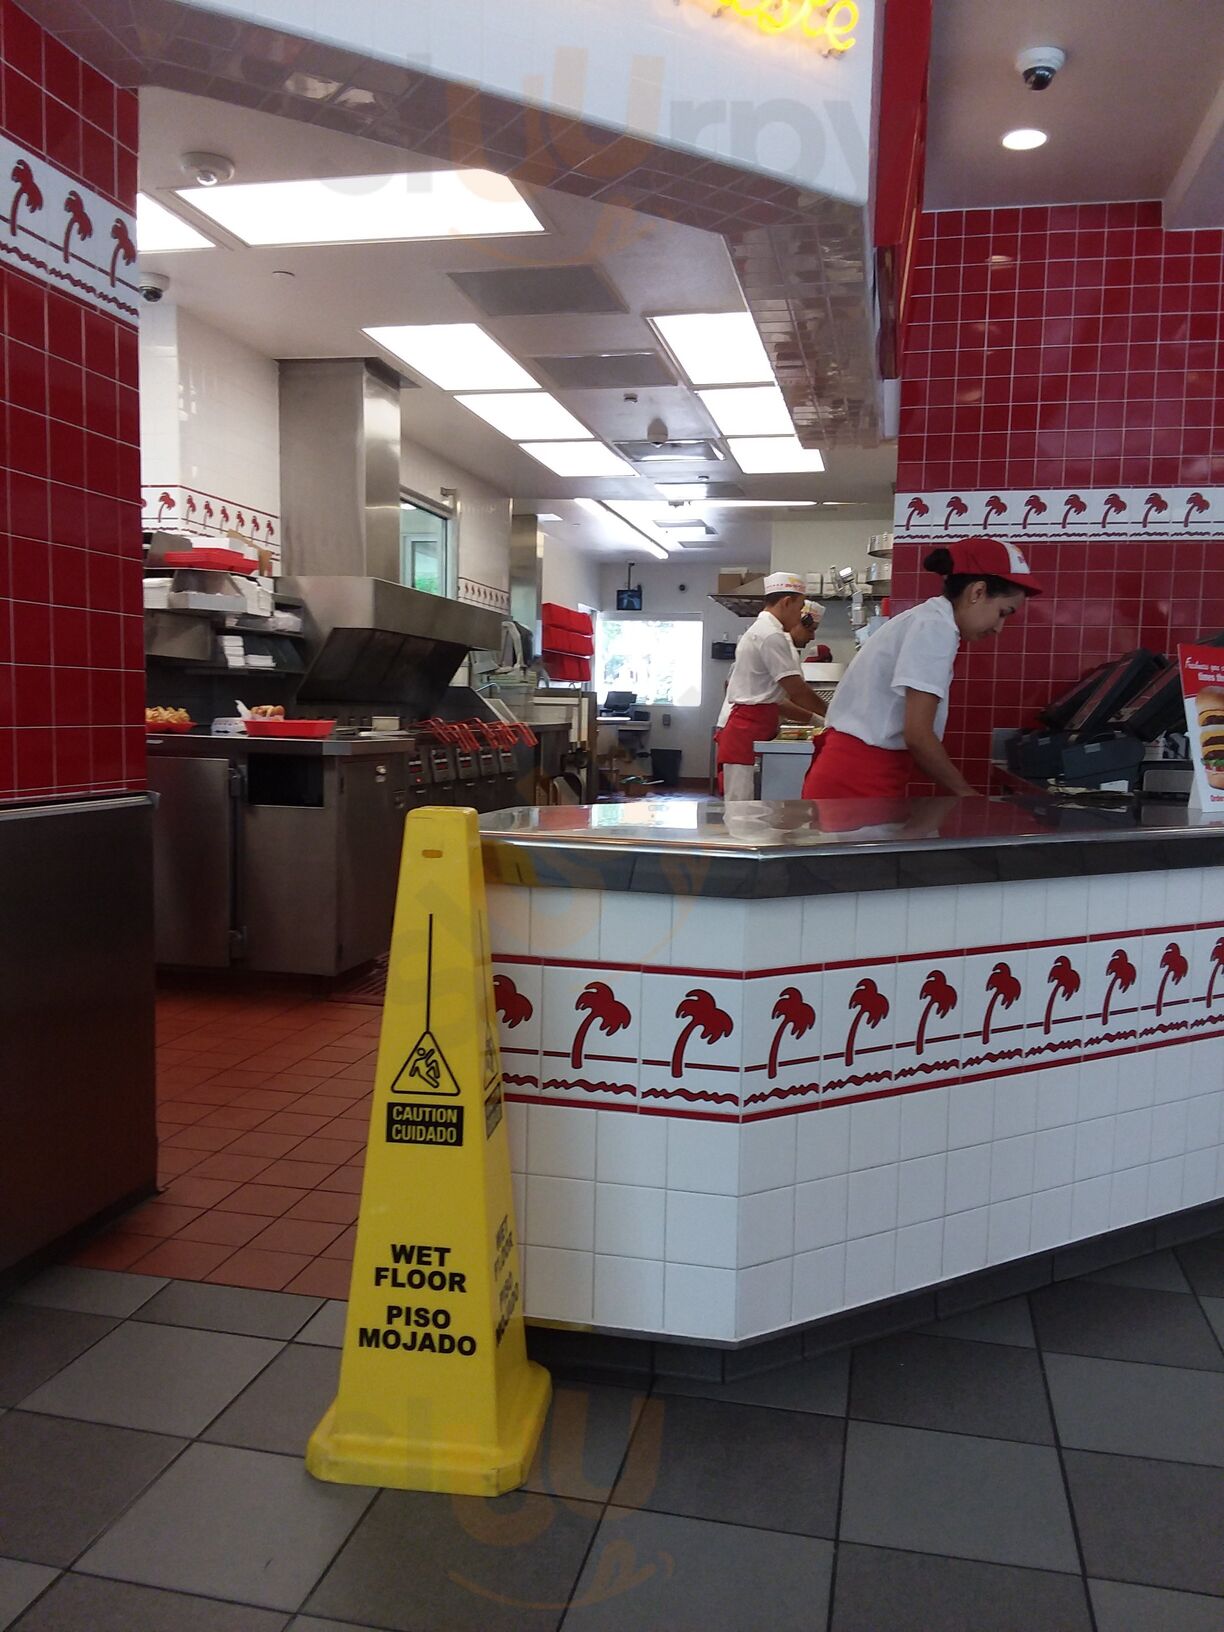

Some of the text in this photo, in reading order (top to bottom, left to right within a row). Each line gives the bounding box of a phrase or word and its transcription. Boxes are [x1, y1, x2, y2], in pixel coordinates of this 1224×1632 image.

[392, 1106, 458, 1125] CAUTION
[391, 1124, 457, 1144] CUIDADO
[390, 1243, 451, 1268] WET
[374, 1267, 467, 1293] FLOOR
[386, 1305, 451, 1330] PISO
[358, 1328, 478, 1357] MOJADO
